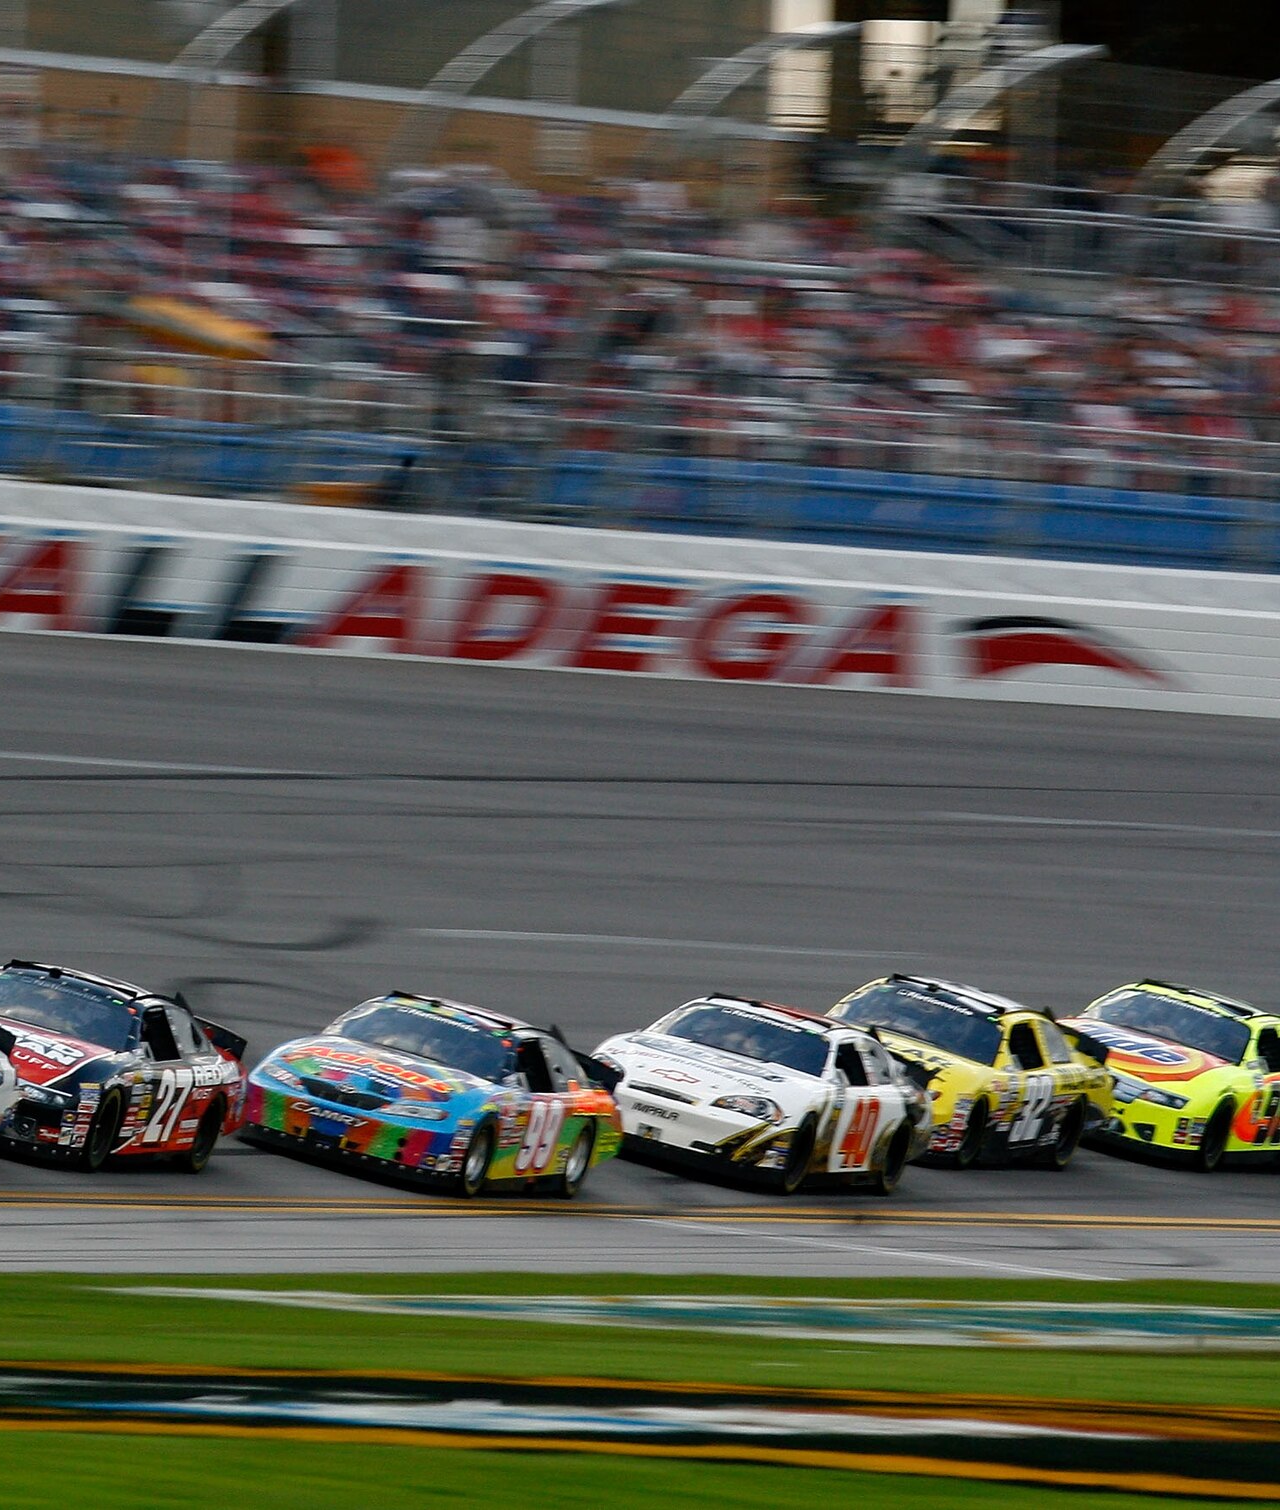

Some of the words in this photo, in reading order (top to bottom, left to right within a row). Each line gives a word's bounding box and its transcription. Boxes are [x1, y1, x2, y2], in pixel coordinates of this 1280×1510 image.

[907, 990, 974, 1016] Nationwide
[406, 1007, 480, 1032] Nationwide
[732, 1009, 802, 1033] Nationwide
[142, 1068, 193, 1142] 27
[289, 1101, 369, 1128] CAMRY
[631, 1102, 680, 1121] IMPALA
